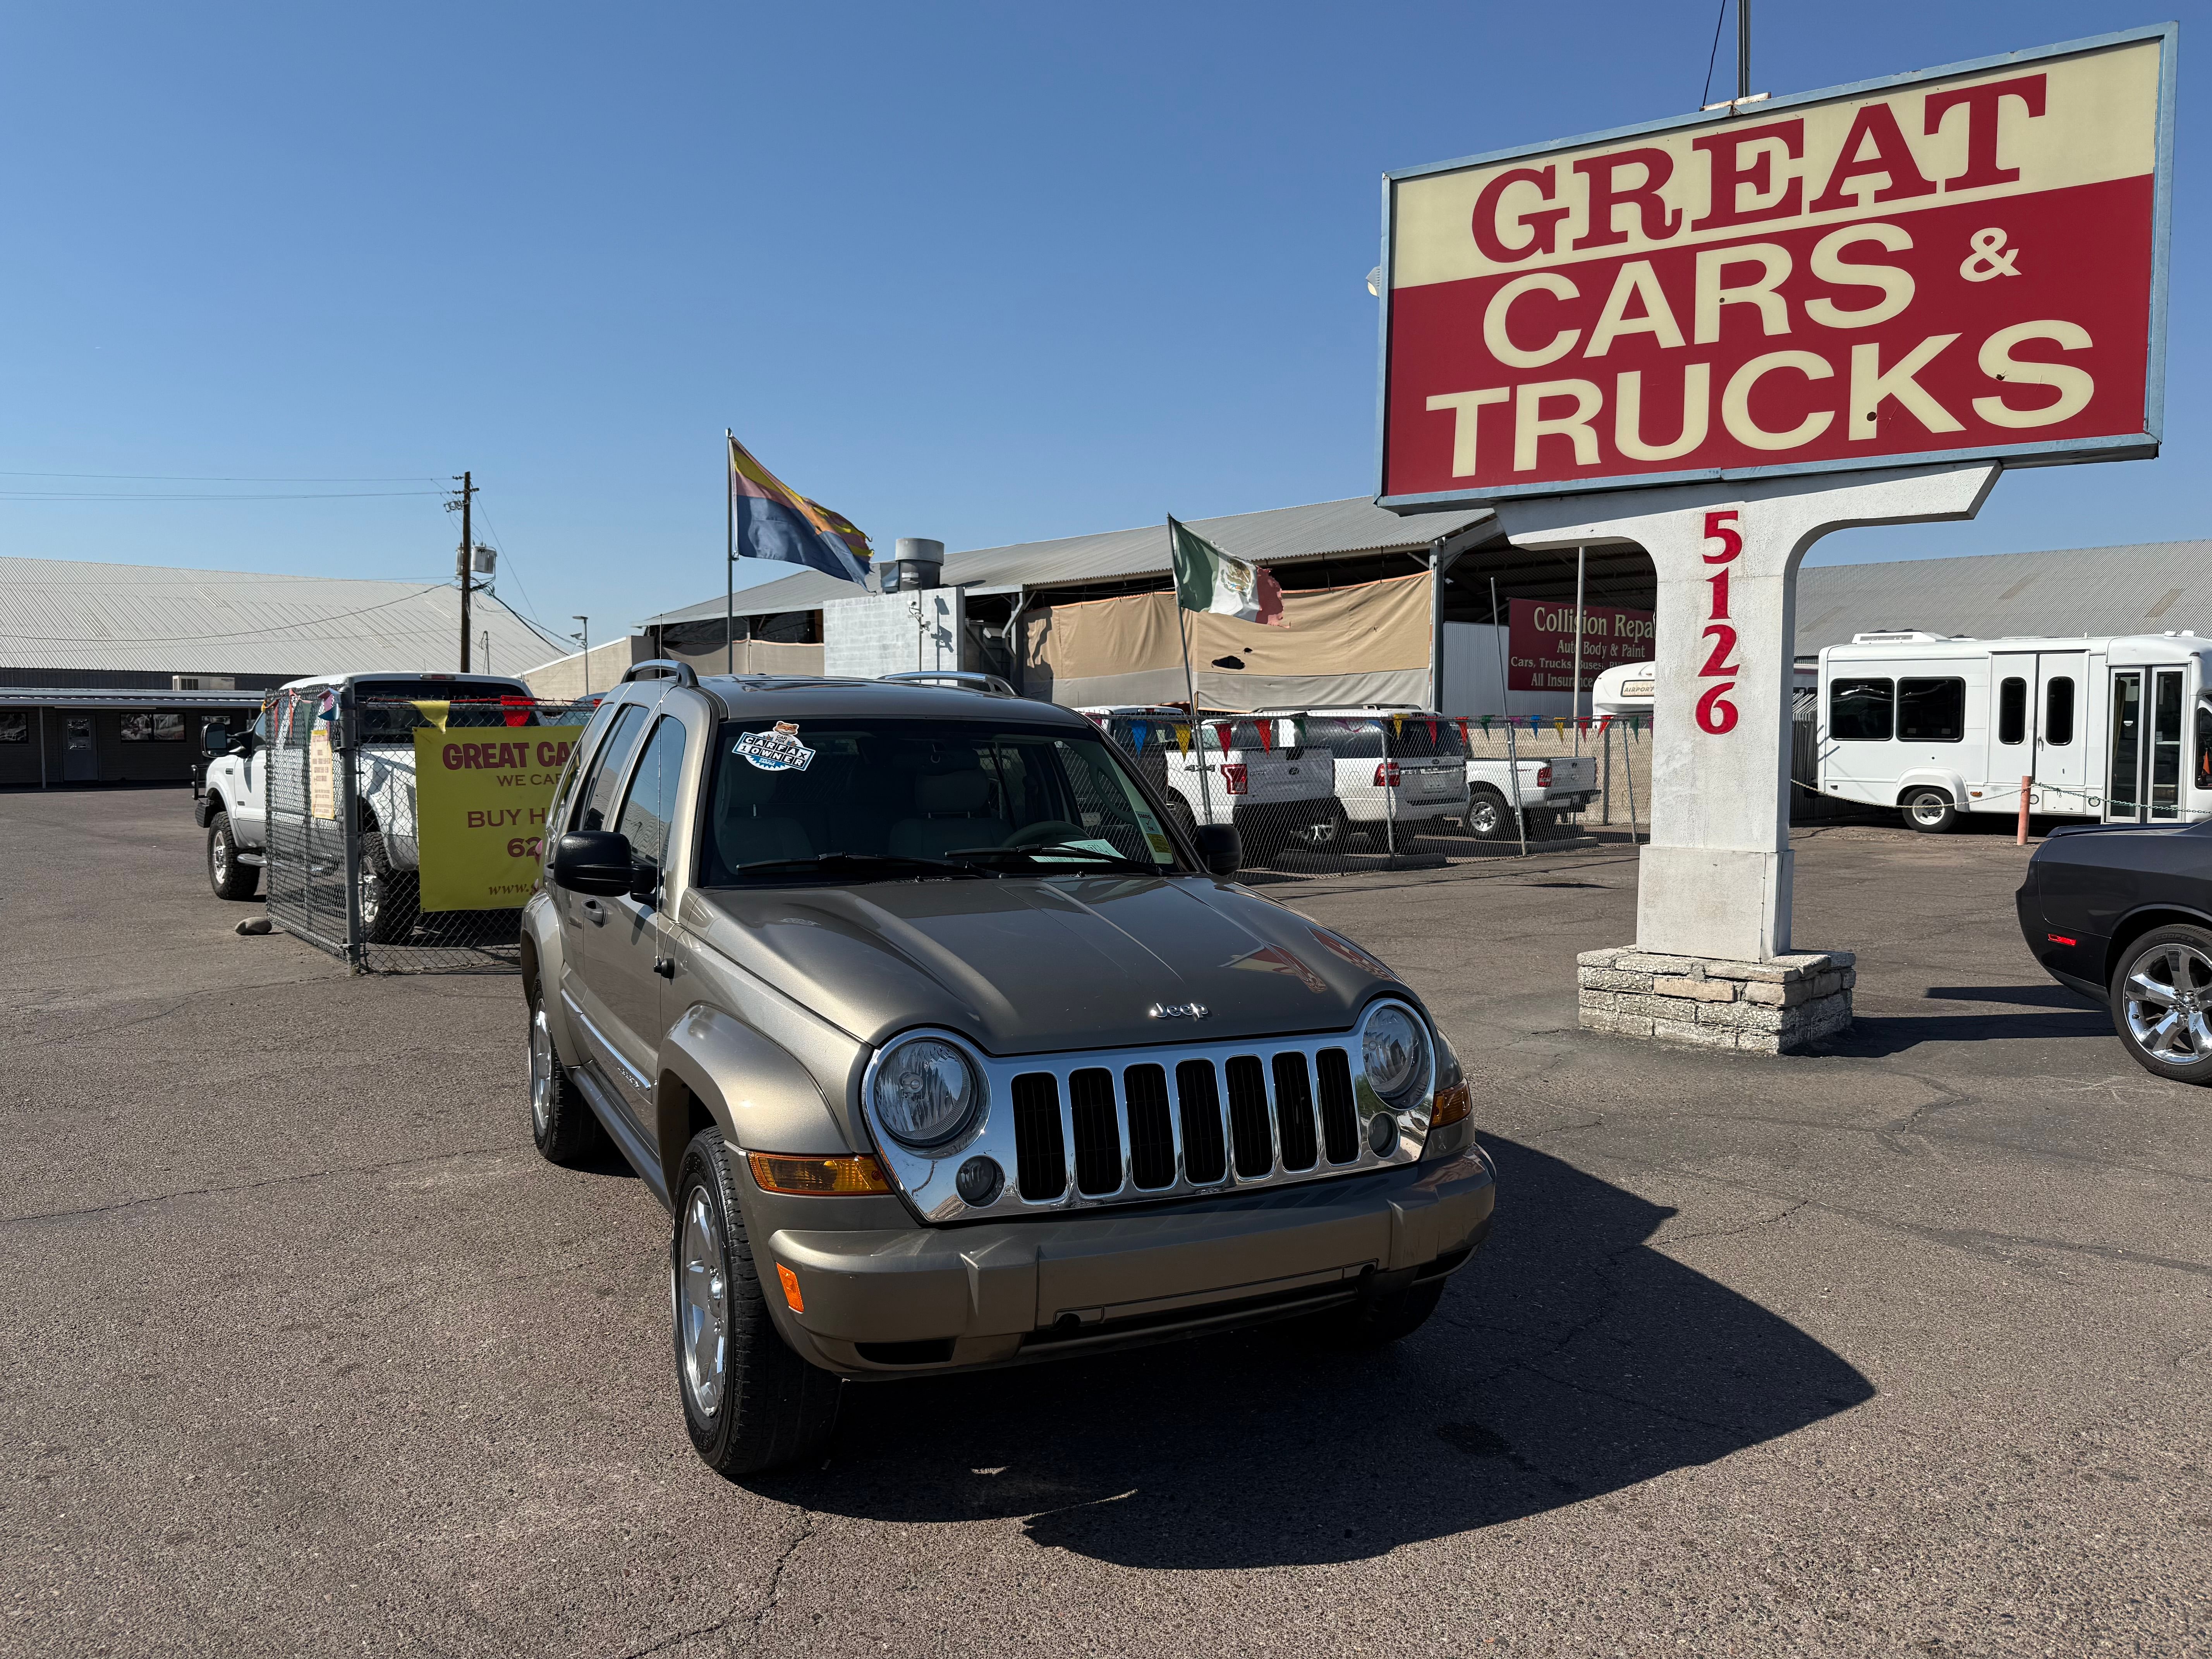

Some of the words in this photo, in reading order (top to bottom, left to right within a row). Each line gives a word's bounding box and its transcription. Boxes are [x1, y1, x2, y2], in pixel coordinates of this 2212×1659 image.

[1472, 73, 2046, 264] GREAT
[1482, 223, 1915, 368] CARS
[1960, 227, 2021, 282] &
[1426, 319, 2095, 478] TRUCKS
[1614, 614, 1656, 642] Repa
[1695, 510, 1743, 735] 5126
[1583, 642, 1607, 659] Body
[1610, 643, 1618, 656] &
[1621, 644, 1645, 658] Paint
[1511, 656, 1535, 668] Cars,
[1539, 658, 1573, 669] Trucks,
[1531, 673, 1543, 686] All
[442, 742, 530, 770] GREAT
[743, 737, 808, 759] CARFAX
[750, 747, 805, 767] OWNER
[496, 775, 526, 787] WE
[467, 809, 522, 828] BUY
[2156, 933, 2194, 942] COOPER
[1149, 1002, 1208, 1019] Jeep
